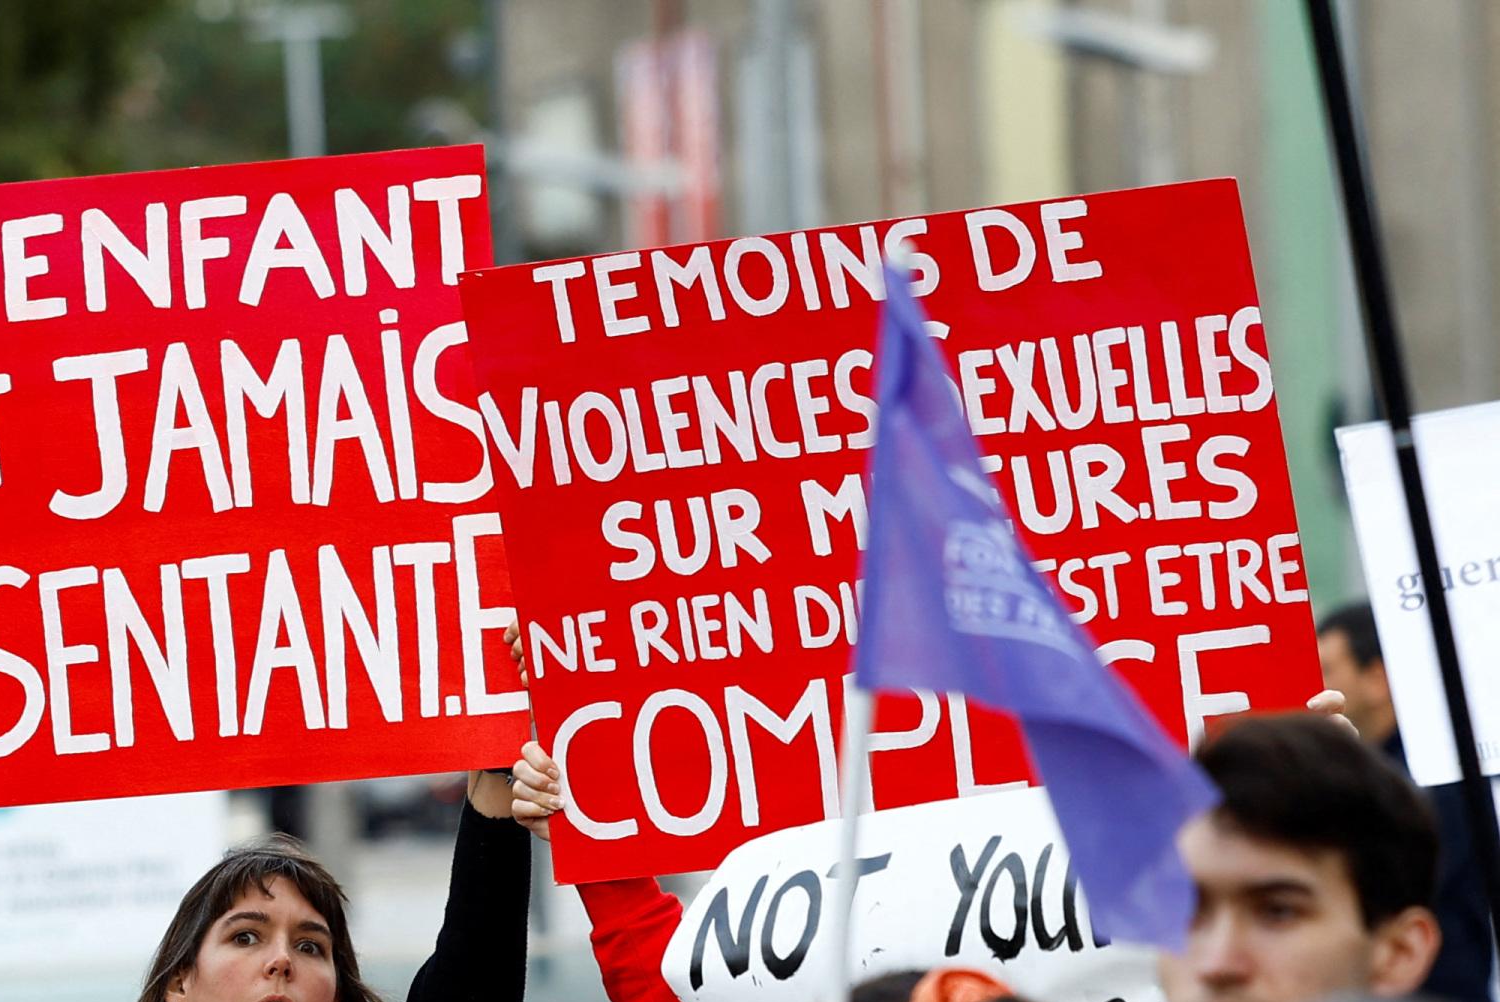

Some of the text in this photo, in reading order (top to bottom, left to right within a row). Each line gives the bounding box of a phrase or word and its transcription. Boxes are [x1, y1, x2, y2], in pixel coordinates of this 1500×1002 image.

[1, 174, 483, 324] ENFANT
[532, 198, 1105, 345] TEMOINS DE
[476, 304, 1275, 490] VIOLENCES EXUELLES
[601, 423, 1258, 583] SUR MUR.ES
[526, 608, 617, 678] NE
[631, 587, 774, 669] RIEN
[1145, 531, 1310, 619] ETRE
[551, 625, 1270, 842] COMPLE
[689, 834, 1113, 992] NOT YOU
